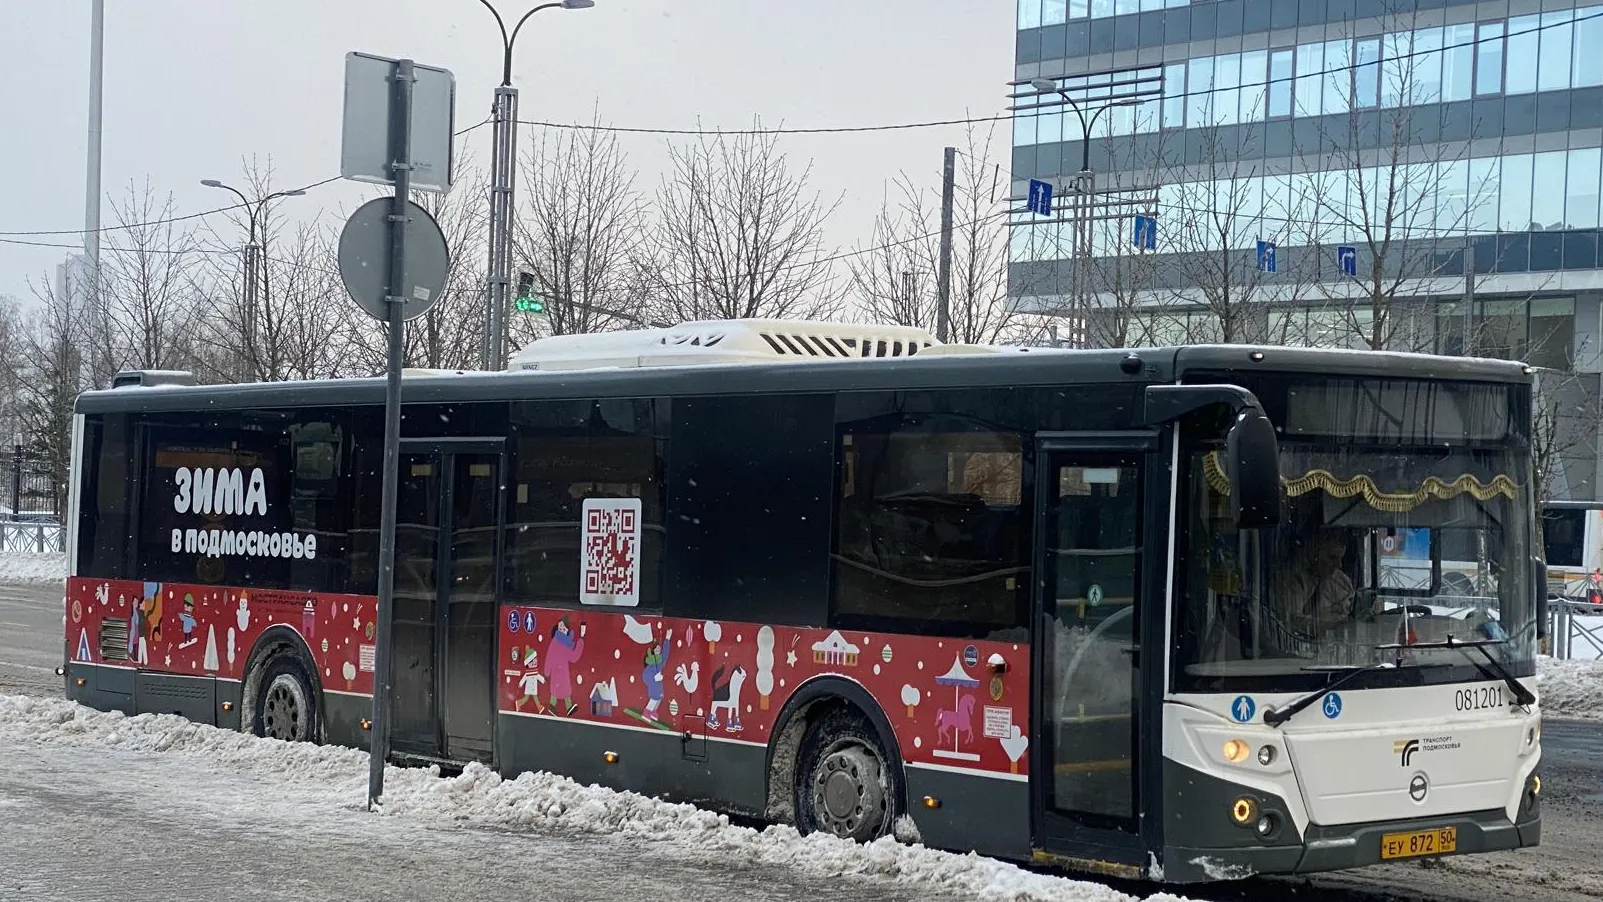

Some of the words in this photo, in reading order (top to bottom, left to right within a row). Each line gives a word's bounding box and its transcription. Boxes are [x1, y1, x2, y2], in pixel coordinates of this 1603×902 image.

[174, 467, 267, 516] ЗИМА
[1455, 686, 1503, 711] 081201
[1422, 736, 1453, 744] ТРАНСПОРТ
[1422, 743, 1461, 752] ПОДМОСКОВЬЯ
[1388, 841, 1405, 855] ЕУ
[1410, 834, 1434, 853] 872
[1440, 831, 1453, 845] 50
